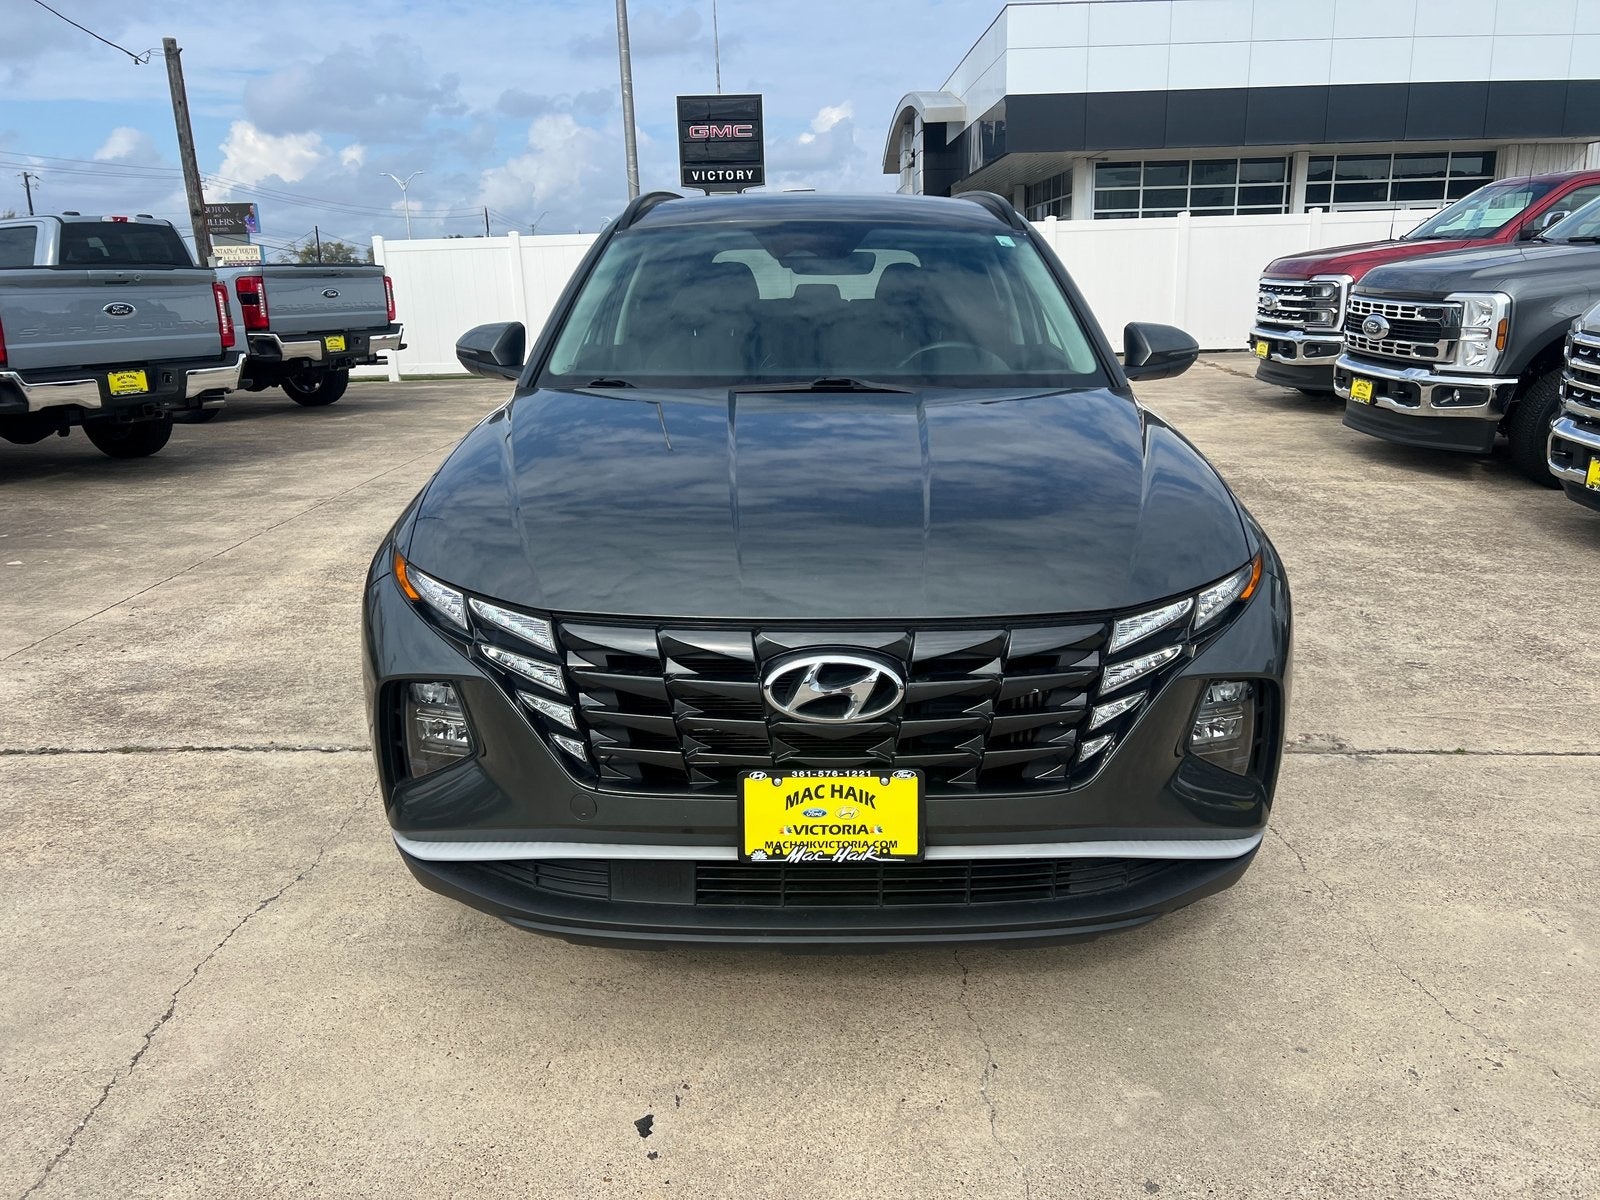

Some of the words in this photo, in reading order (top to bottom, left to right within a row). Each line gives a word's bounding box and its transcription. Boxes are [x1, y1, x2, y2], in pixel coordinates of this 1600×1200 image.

[689, 124, 753, 139] GMC
[691, 170, 754, 181] VICTORY
[207, 218, 235, 226] ILLERS
[110, 305, 129, 315] Ford
[785, 784, 825, 811] MAC
[830, 783, 877, 810] HAIK
[792, 824, 869, 836] VICTORIA
[786, 845, 830, 863] Mac
[832, 845, 882, 862] Haik
